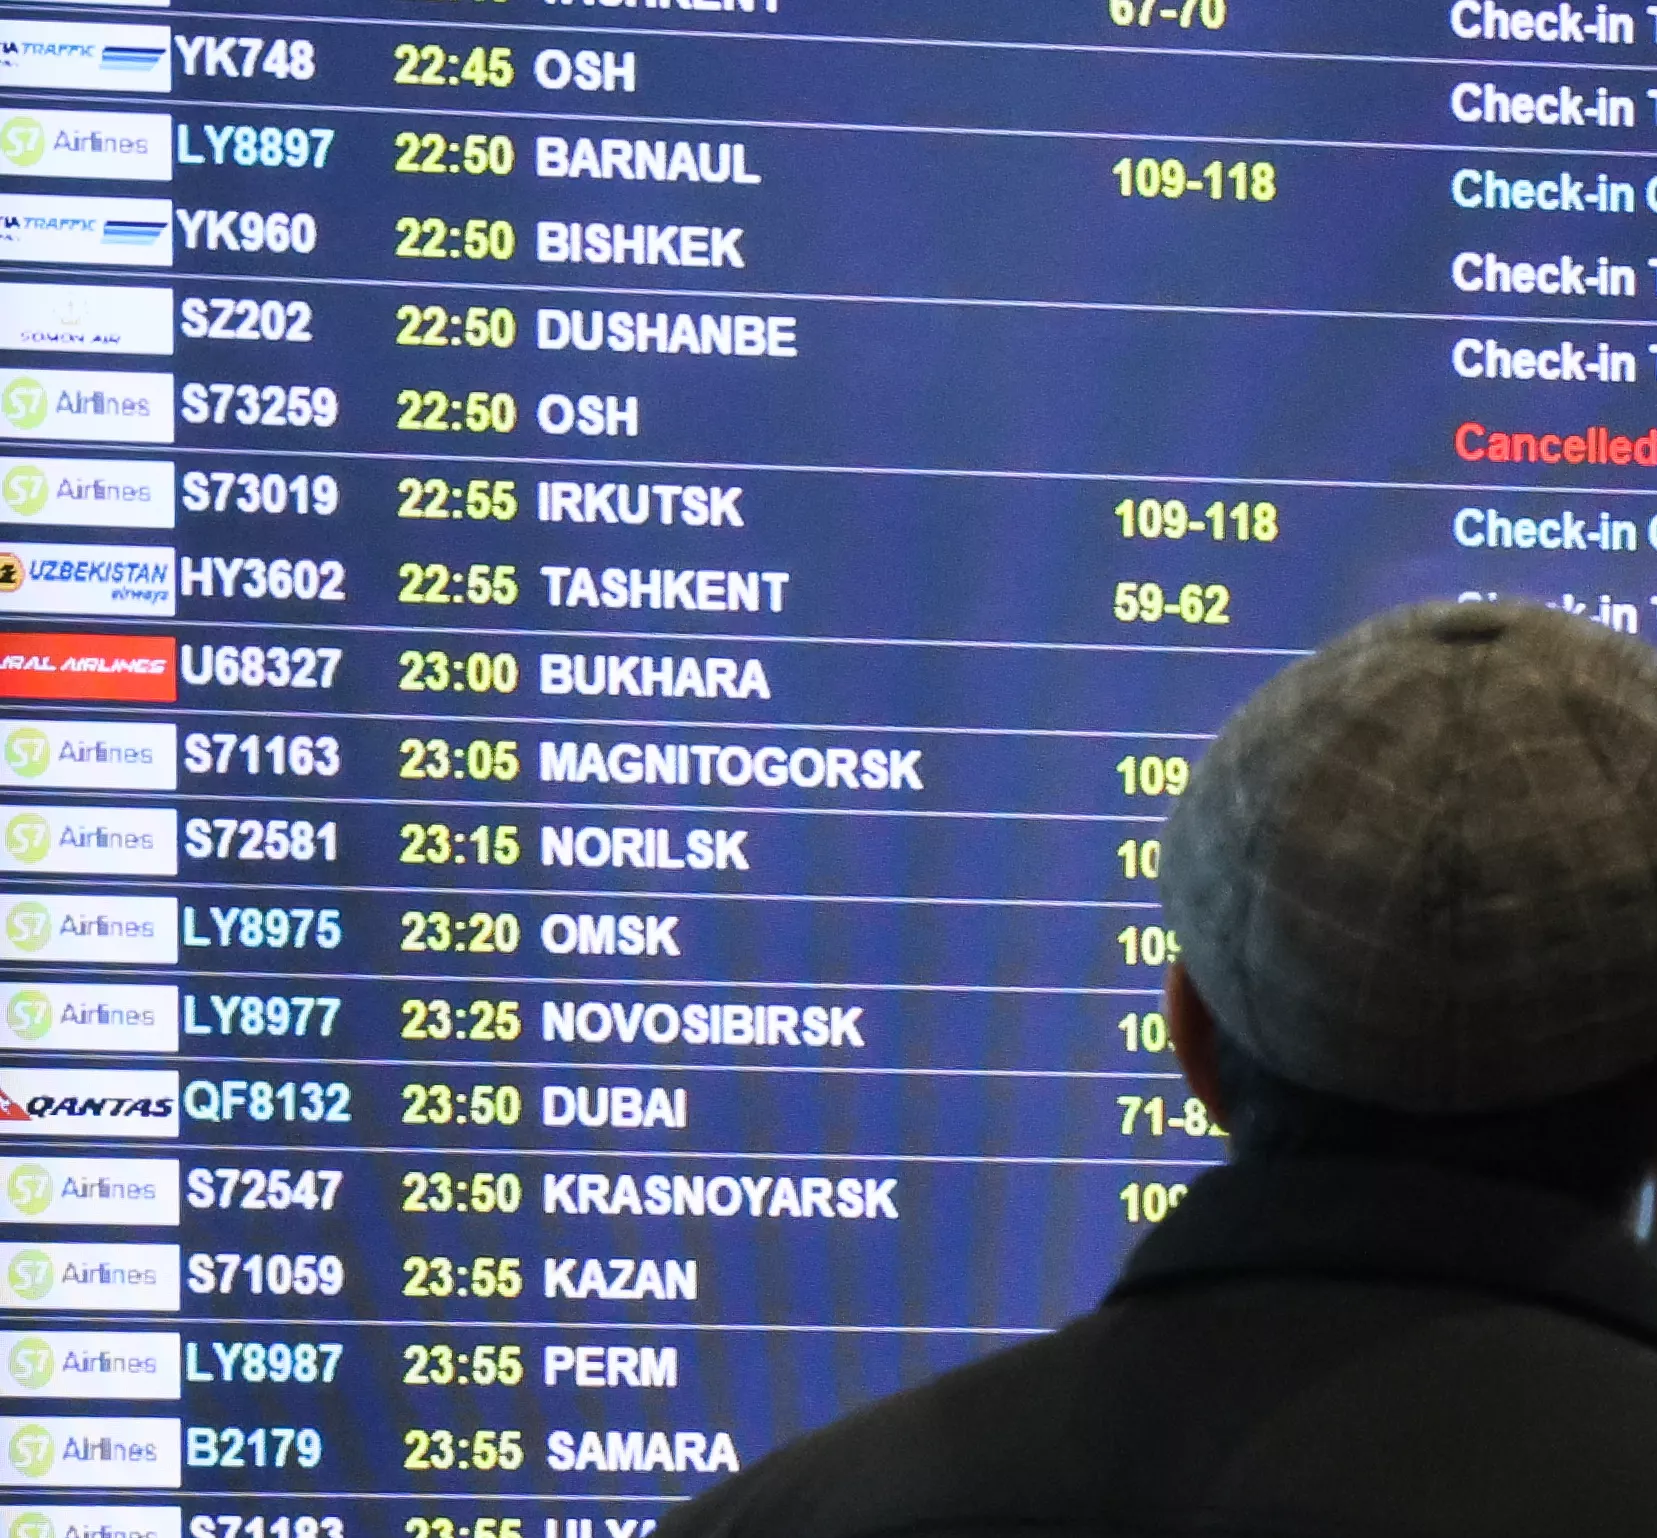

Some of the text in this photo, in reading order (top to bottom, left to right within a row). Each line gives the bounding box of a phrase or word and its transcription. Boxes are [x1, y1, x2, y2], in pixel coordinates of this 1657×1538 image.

[1451, 0, 1634, 44] Check-in
[178, 124, 334, 168] LY8897
[395, 132, 514, 174] 22:50
[537, 137, 761, 184] BARNAUL
[1113, 158, 1276, 201] 109-118
[1452, 169, 1634, 212] Check-in
[176, 209, 317, 253] YK960
[396, 217, 515, 259] 22:50
[537, 222, 745, 268] BISHKEK
[1452, 252, 1635, 296] Check-in
[181, 298, 312, 341] SZ202
[396, 305, 515, 348] 22:50
[537, 309, 798, 357] DUSHANBE
[1452, 338, 1636, 382] Check-in
[183, 472, 338, 515] S73019
[398, 478, 517, 520] 22:55
[538, 482, 744, 527] IRKUTSK
[1115, 499, 1278, 541] 109-118
[1454, 508, 1637, 551] Check-in
[29, 560, 168, 583] UZBEKISTAN
[181, 557, 345, 600] HY3602
[399, 563, 518, 604] 22:55
[540, 566, 789, 612] TASHKENT
[1114, 582, 1229, 624] 59-62
[181, 645, 771, 699] U68327 23:00 BUKHARA
[185, 733, 924, 790] S71163 23:05 MAGNITOGORSK
[185, 818, 749, 870] S72581 23:15 NORILSK
[184, 907, 680, 956] LY8975 23:20 OMSK
[184, 995, 865, 1047] LY8977 23:25 NOVOSIBIRSK
[27, 1095, 173, 1117] QANTAS
[184, 1080, 351, 1122] QF8132
[402, 1084, 521, 1125] 23:50
[543, 1086, 686, 1128] DUBAI
[187, 1168, 899, 1219] S72547 23:50 KRASNOYARSK
[186, 1342, 677, 1387] LY8987 23:55 PERM
[187, 1427, 739, 1472] B2179 23:55 SAMARA
